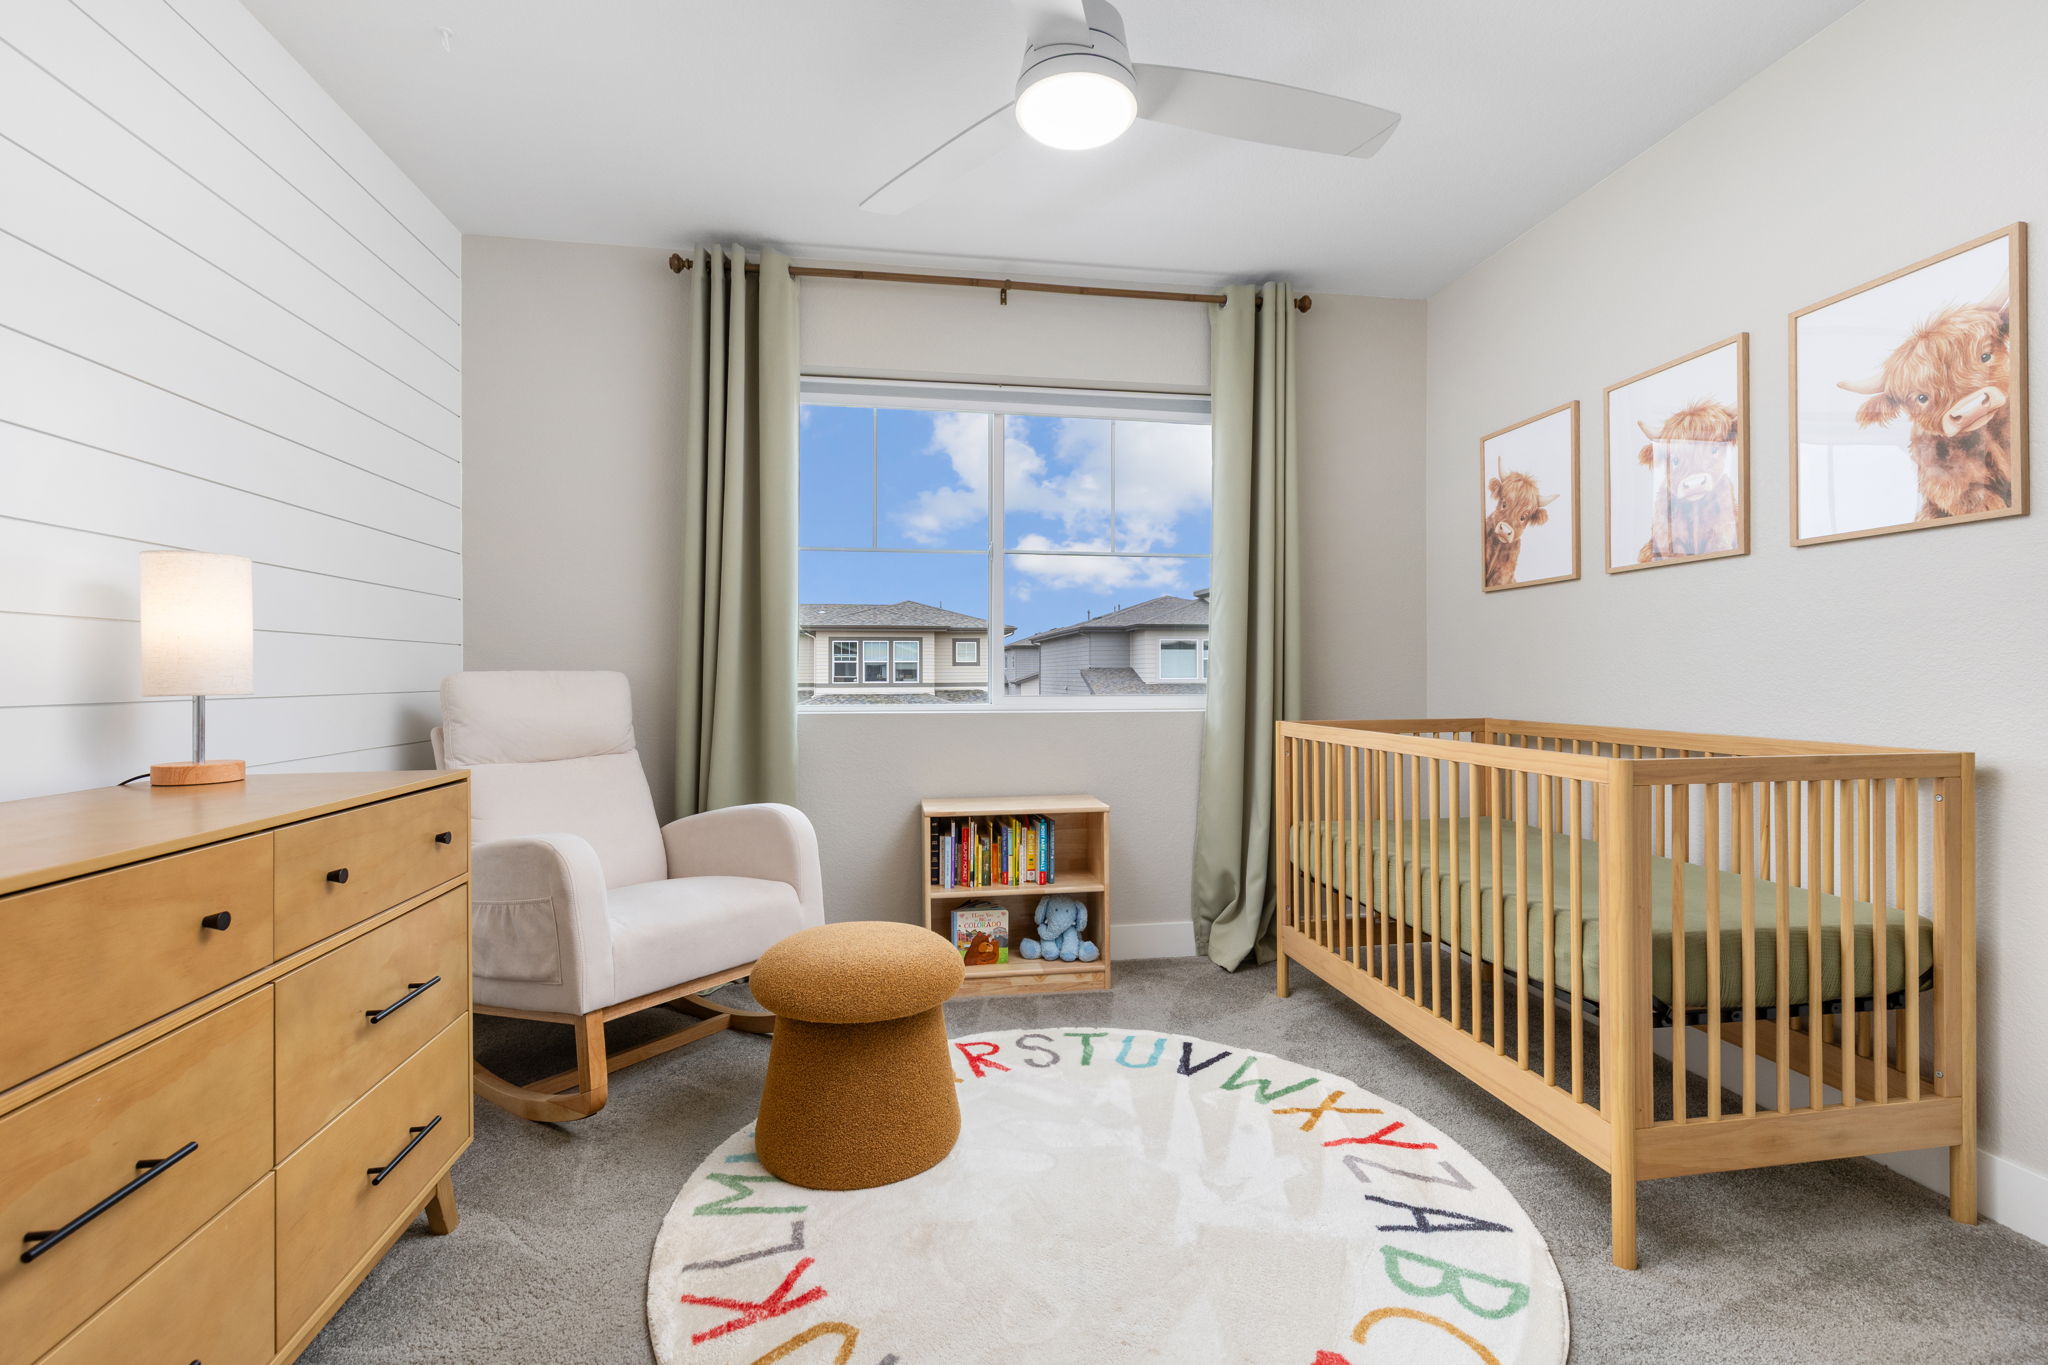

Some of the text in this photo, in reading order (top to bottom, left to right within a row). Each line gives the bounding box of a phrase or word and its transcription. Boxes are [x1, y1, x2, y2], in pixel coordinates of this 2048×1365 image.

[963, 920, 1002, 929] COLORADO
[955, 1041, 1012, 1078] R
[1015, 1033, 1061, 1068] S
[1064, 1032, 1109, 1066] T
[1115, 1035, 1168, 1069] U
[1177, 1041, 1233, 1077] V
[1219, 1056, 1321, 1104] W
[1271, 1090, 1384, 1132] X
[1321, 1120, 1438, 1150] Y
[1342, 1154, 1478, 1191] Z
[692, 1172, 809, 1217] M
[1364, 1194, 1514, 1233] A
[682, 1220, 805, 1274] L
[1379, 1244, 1531, 1320] B
[680, 1256, 828, 1346] K
